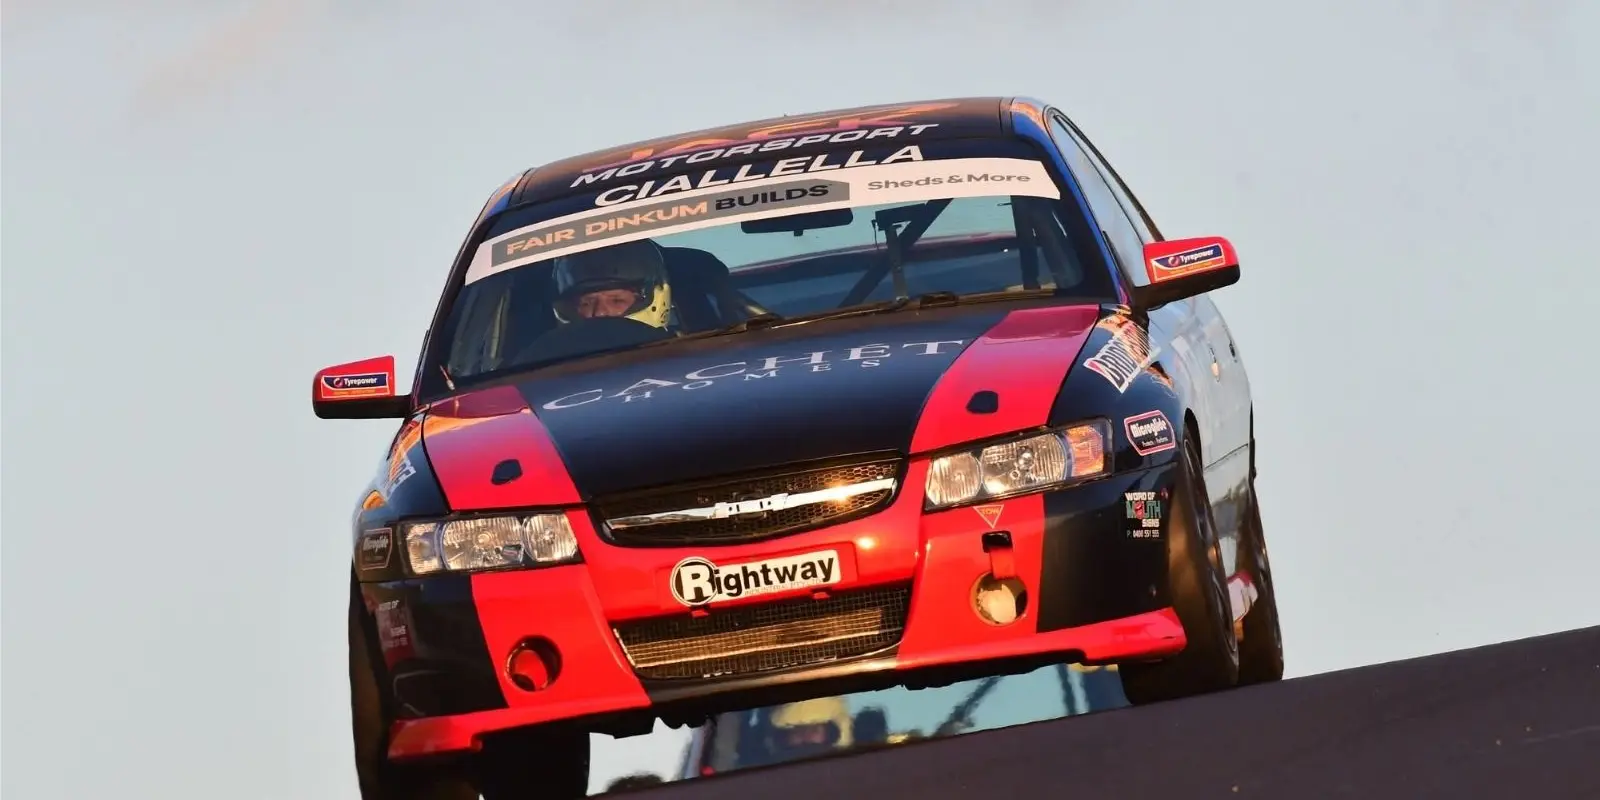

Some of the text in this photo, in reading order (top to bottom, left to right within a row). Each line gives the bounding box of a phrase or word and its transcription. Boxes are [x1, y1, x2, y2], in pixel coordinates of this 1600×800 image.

[570, 123, 939, 188] MOTORSPORT
[594, 144, 924, 207] CIALLELLA
[506, 185, 830, 256] FAIR DINKUM BUILDS
[1180, 249, 1214, 264] Tyrepower
[344, 377, 378, 387] Tyrepower
[541, 339, 966, 411] CACHET
[678, 556, 834, 601] Rightway
